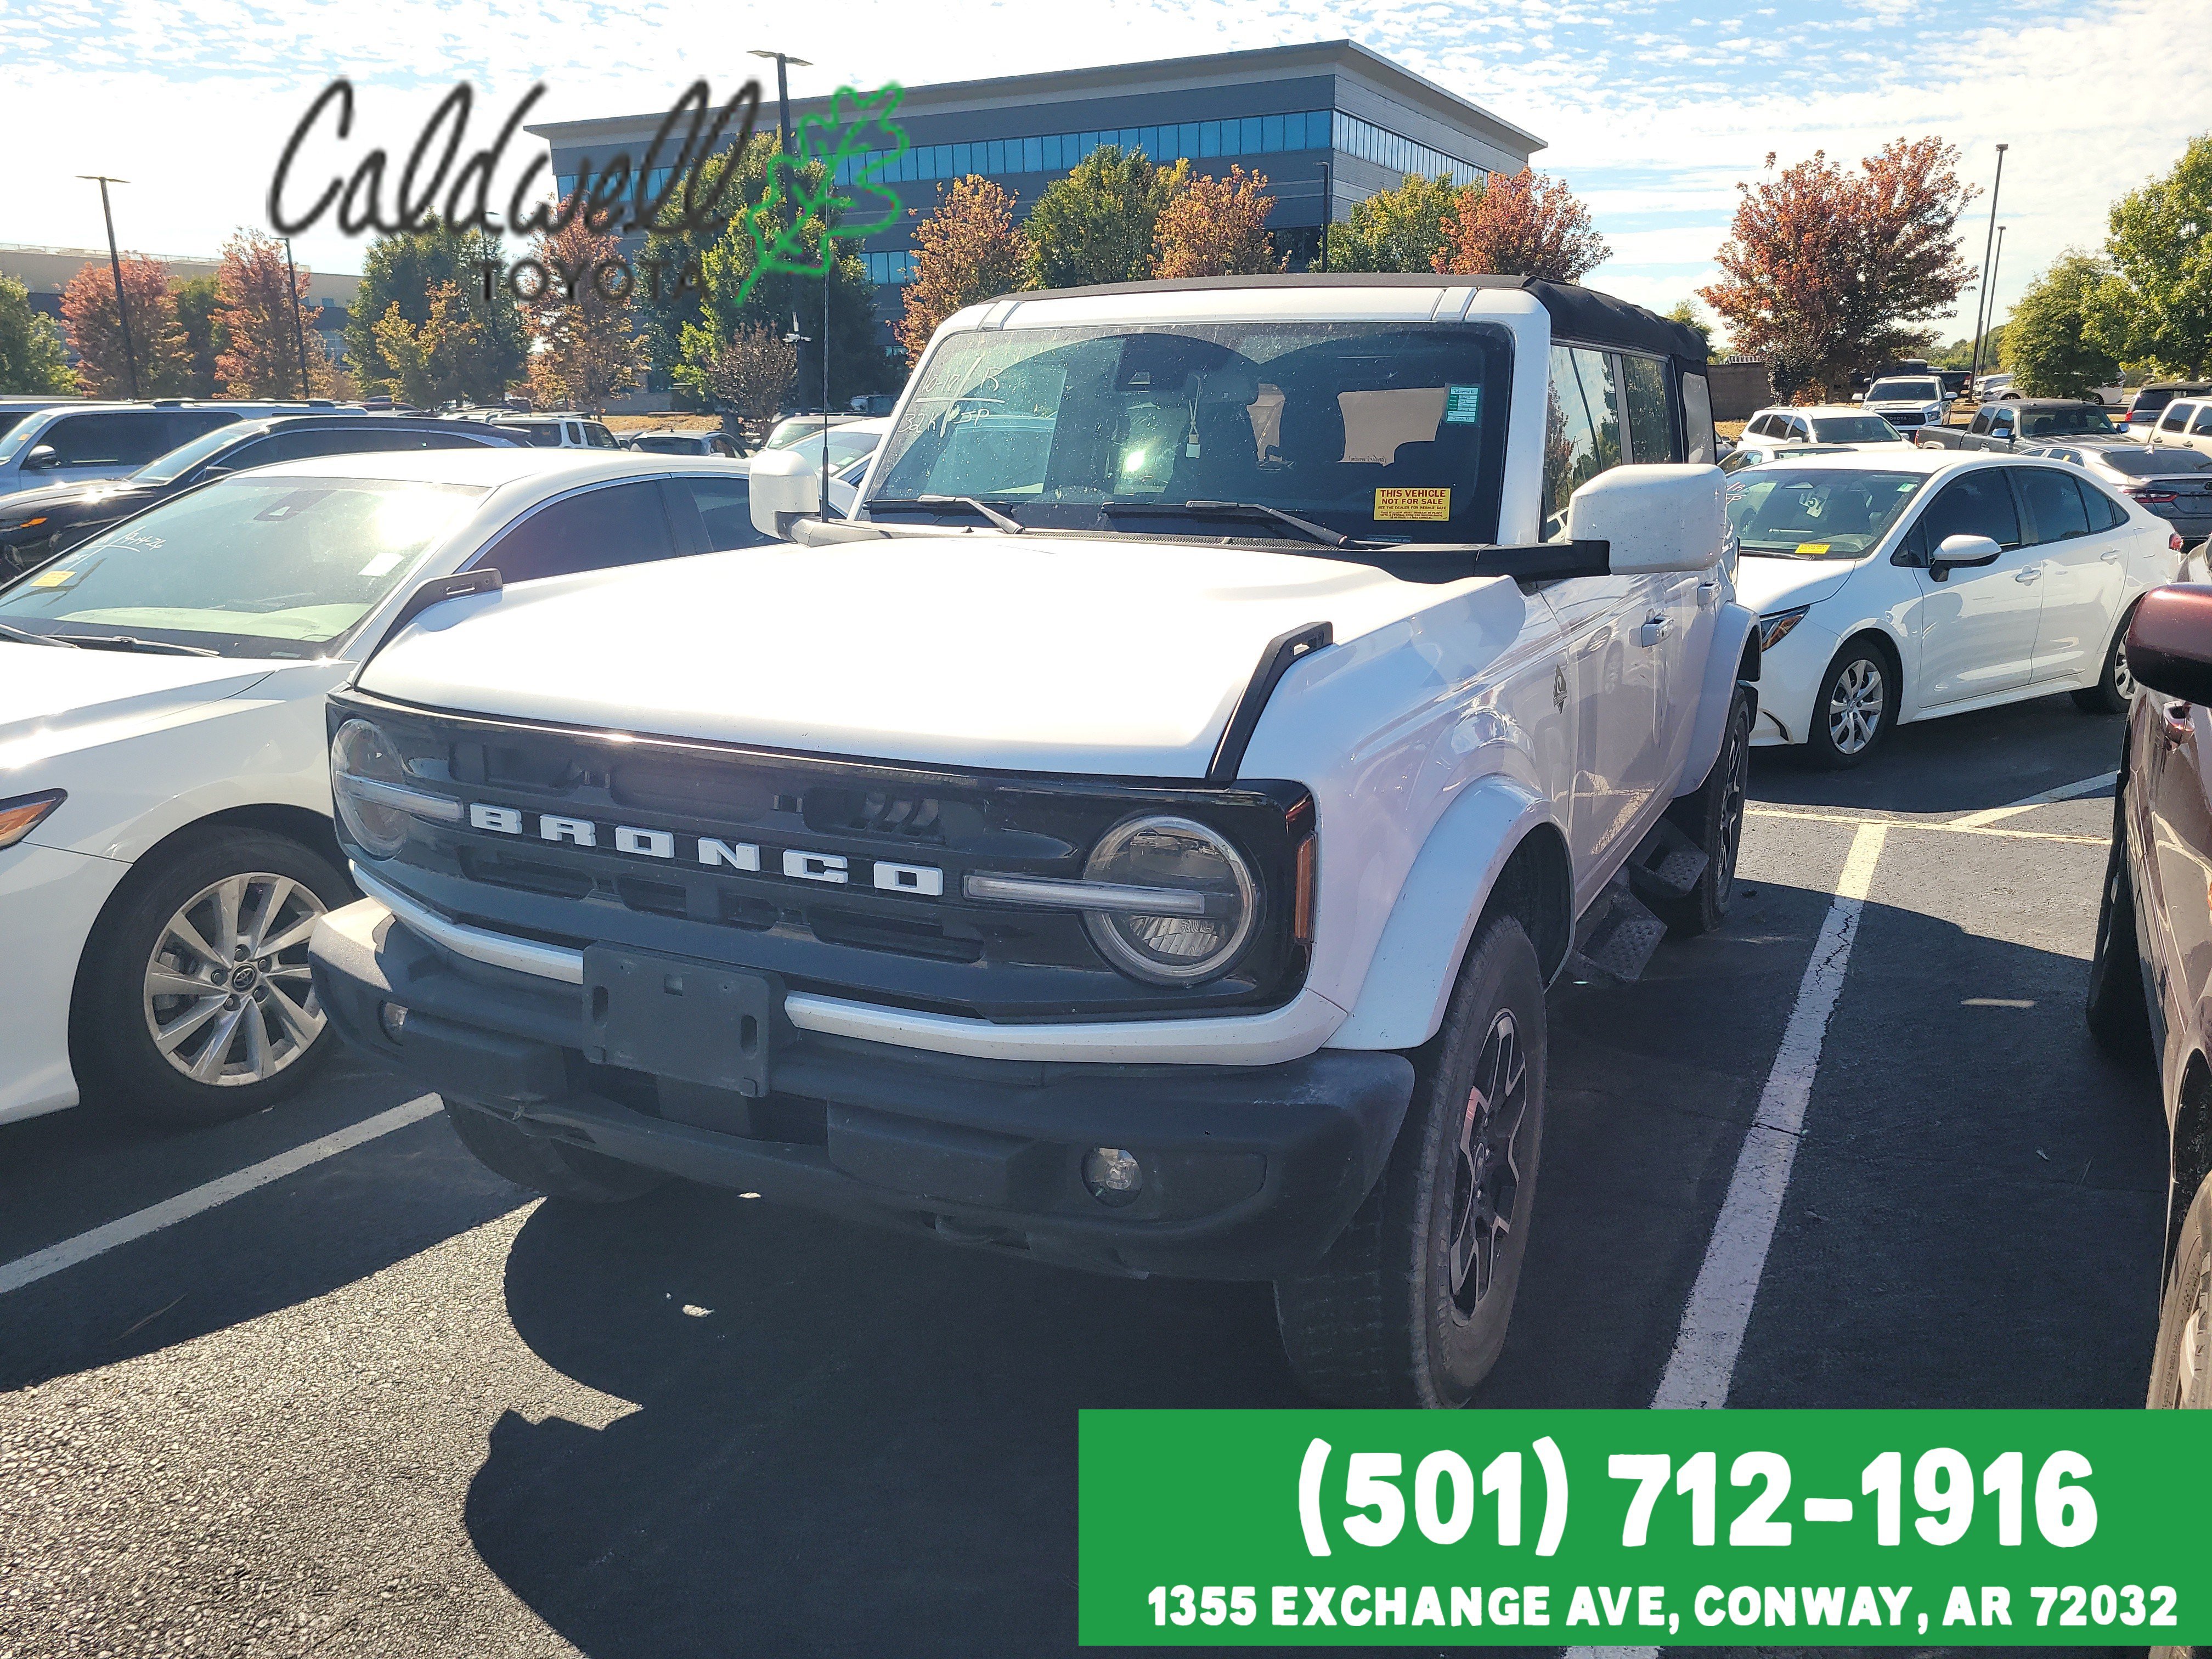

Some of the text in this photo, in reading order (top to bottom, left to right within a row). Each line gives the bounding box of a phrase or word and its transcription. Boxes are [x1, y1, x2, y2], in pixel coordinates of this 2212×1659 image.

[979, 366, 1003, 392] R
[1380, 489, 1446, 498] THIS VEHICLE
[469, 801, 944, 896] BRONCO
